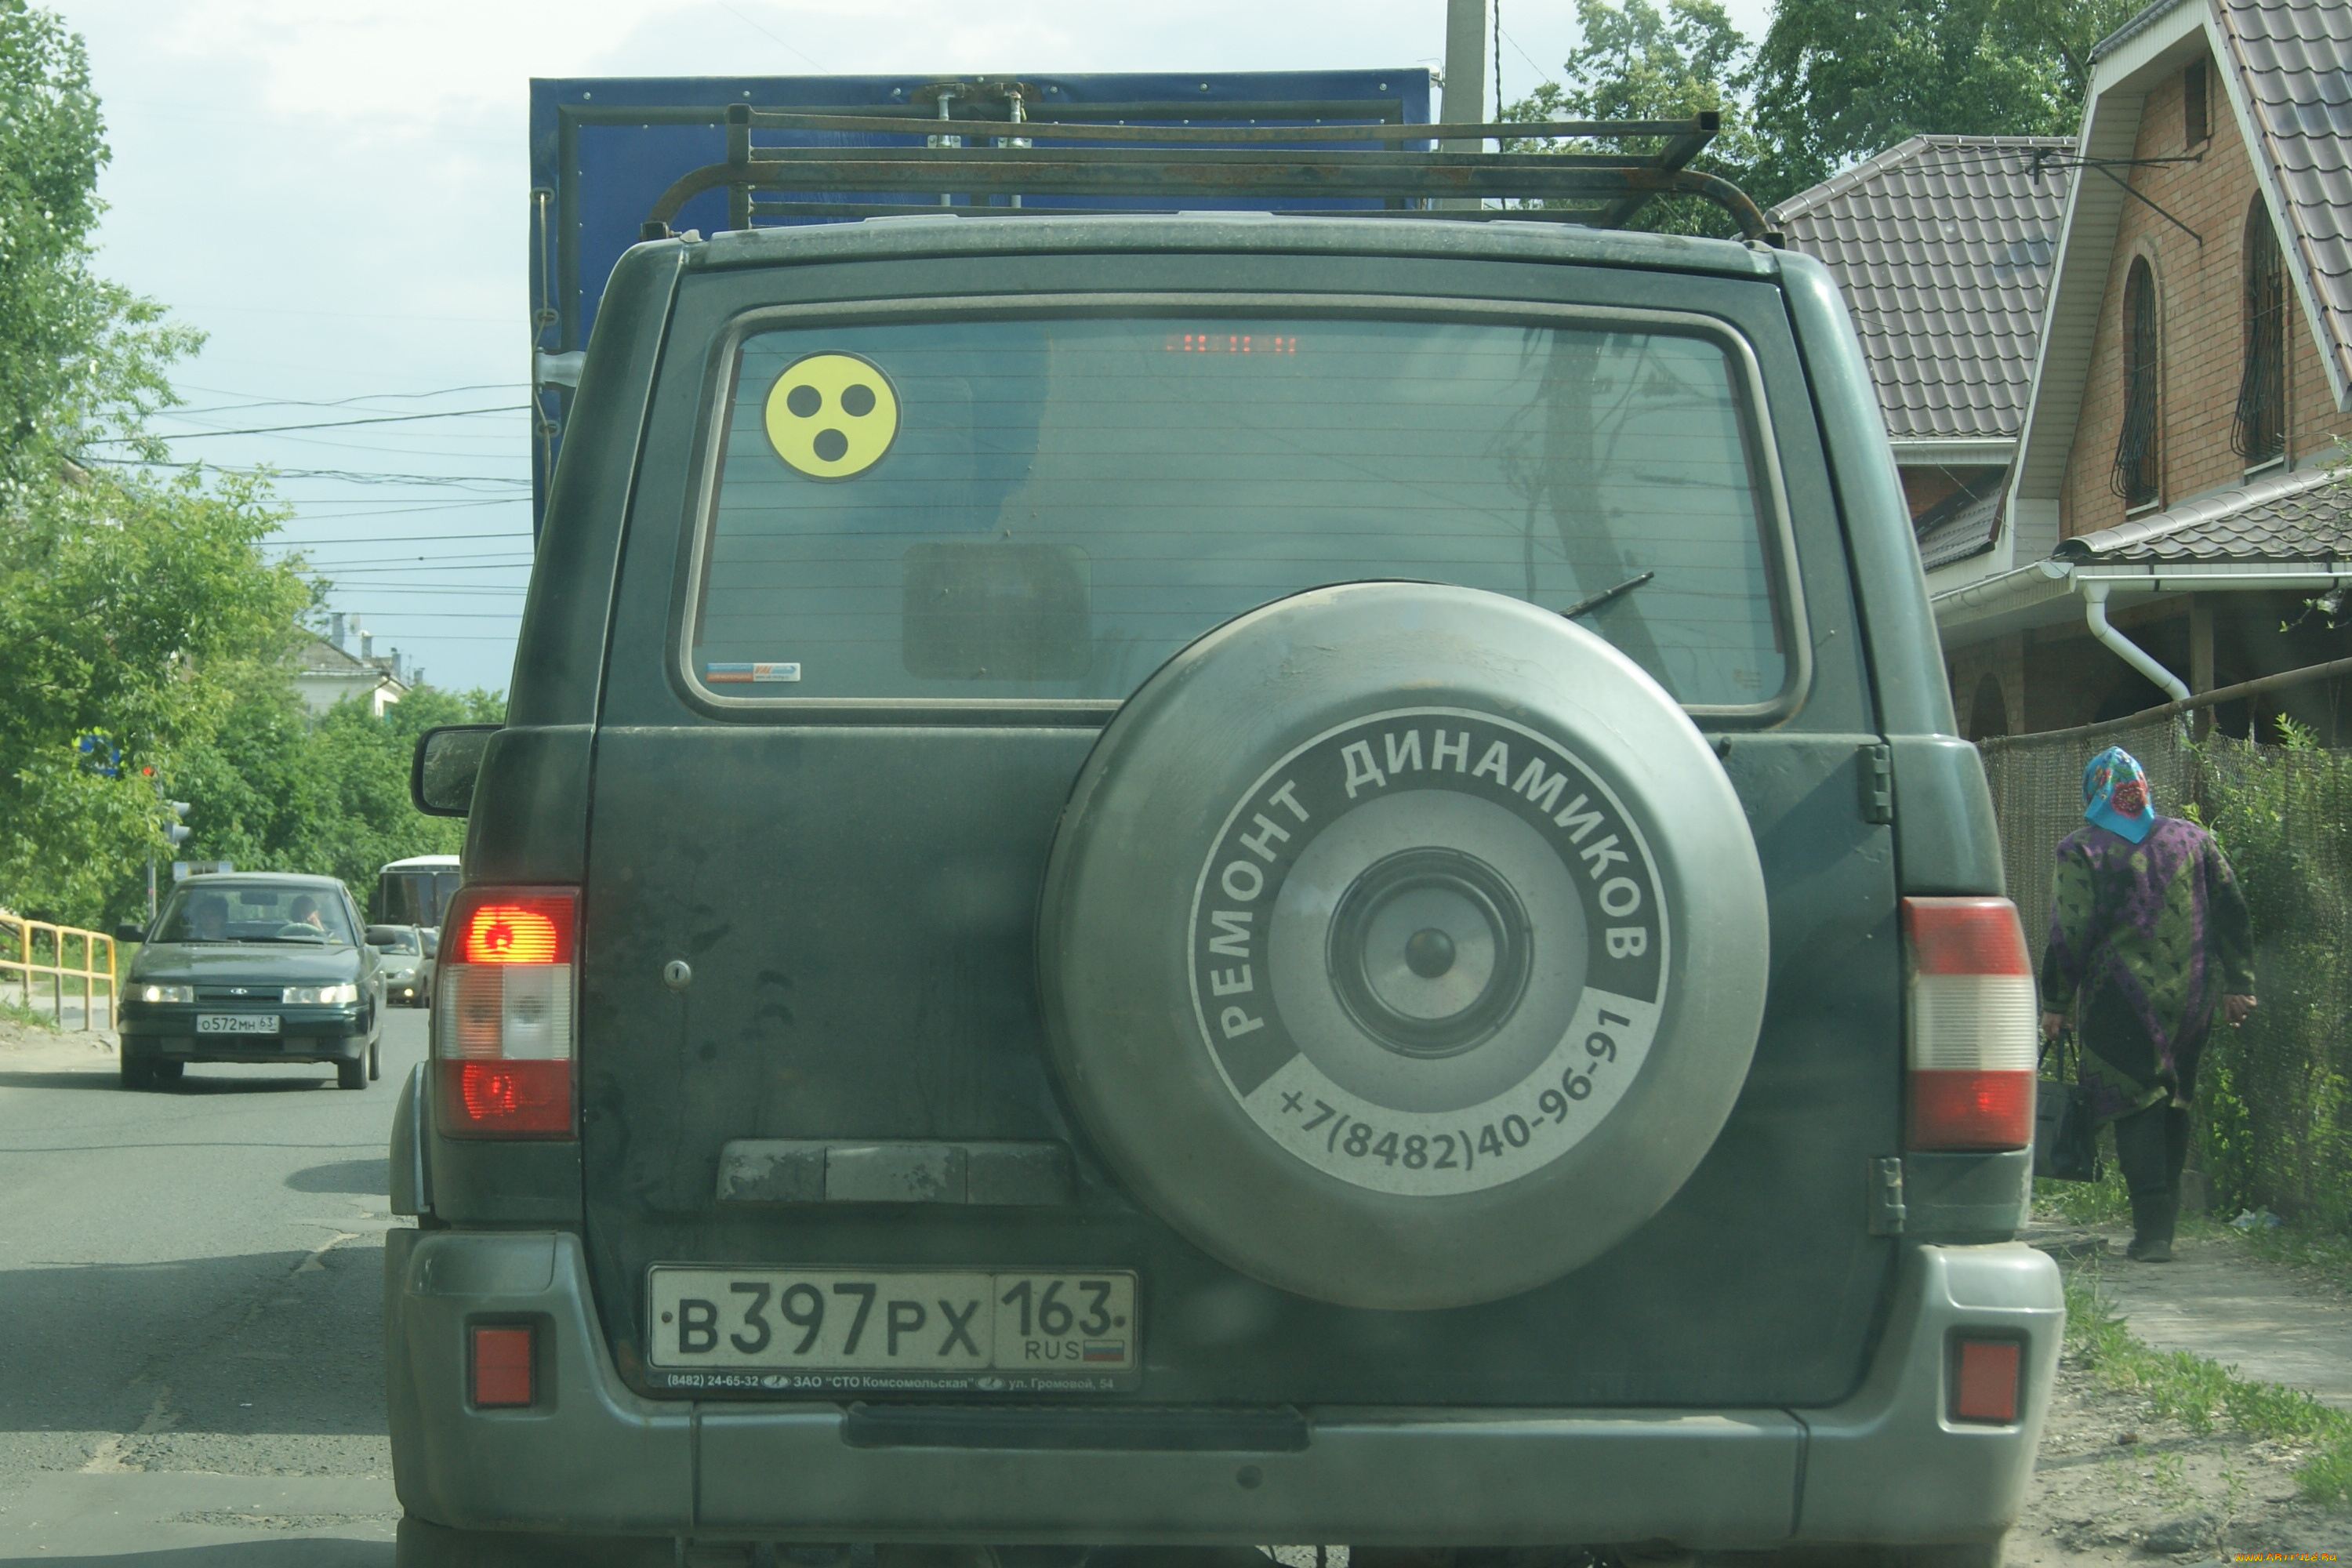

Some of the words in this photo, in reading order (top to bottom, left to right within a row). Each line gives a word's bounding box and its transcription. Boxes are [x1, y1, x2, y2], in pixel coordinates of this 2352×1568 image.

[1209, 779, 1310, 1040] РЕМОНТ
[1340, 728, 1647, 960] ДИНАМИКОВ
[260, 1018, 273, 1028] 63
[1279, 1007, 1631, 1170] +7(8482)40-96-91
[679, 1282, 980, 1356] В397РХ
[1000, 1280, 1112, 1338] 163
[1025, 1340, 1080, 1360] RUS
[667, 1374, 704, 1388] (8482)
[707, 1375, 759, 1387] 24-65-32
[793, 1375, 822, 1388] ЗАО
[1008, 1380, 1028, 1390] ул.
[1100, 1378, 1113, 1388] 54
